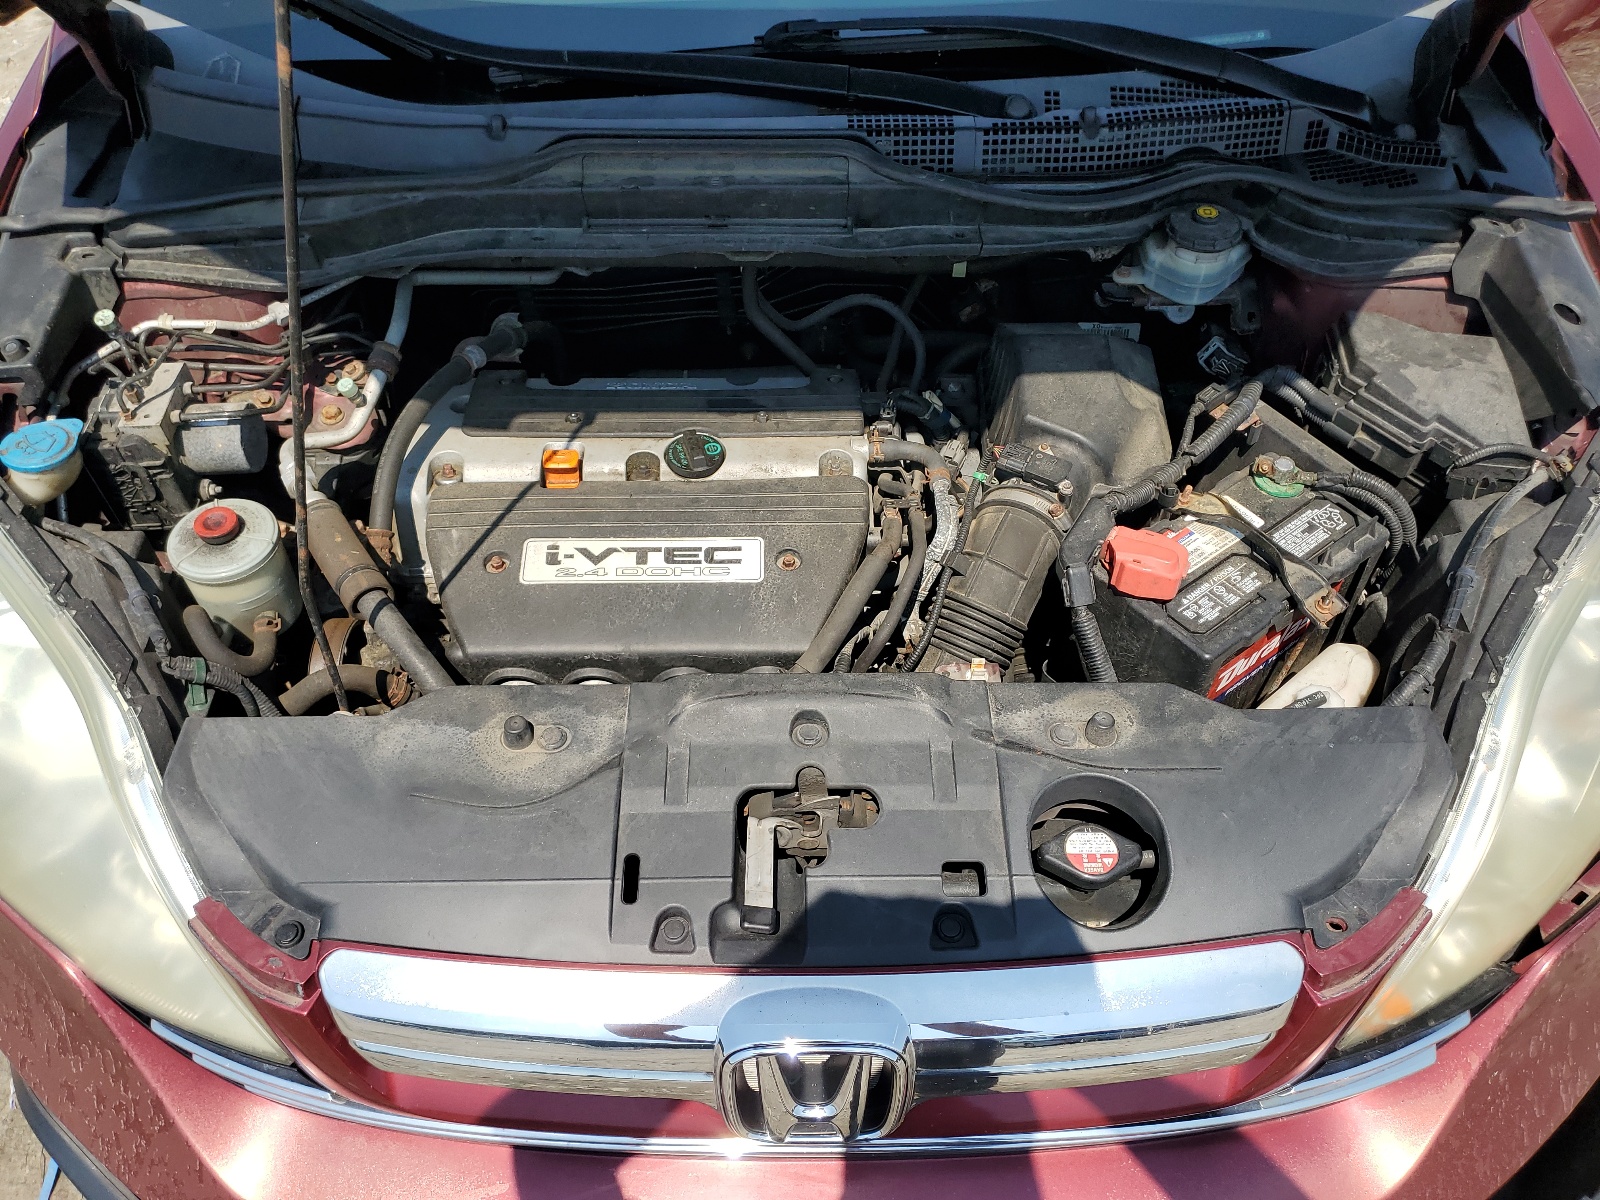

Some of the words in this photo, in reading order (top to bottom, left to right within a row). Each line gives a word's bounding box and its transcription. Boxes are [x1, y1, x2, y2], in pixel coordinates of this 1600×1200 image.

[545, 544, 743, 566] i-VTEC
[555, 566, 609, 578] 2.4
[615, 566, 731, 578] DOHC
[1186, 581, 1212, 601] DANGER
[1214, 565, 1236, 583] POISON
[1215, 617, 1311, 693] Duralas
